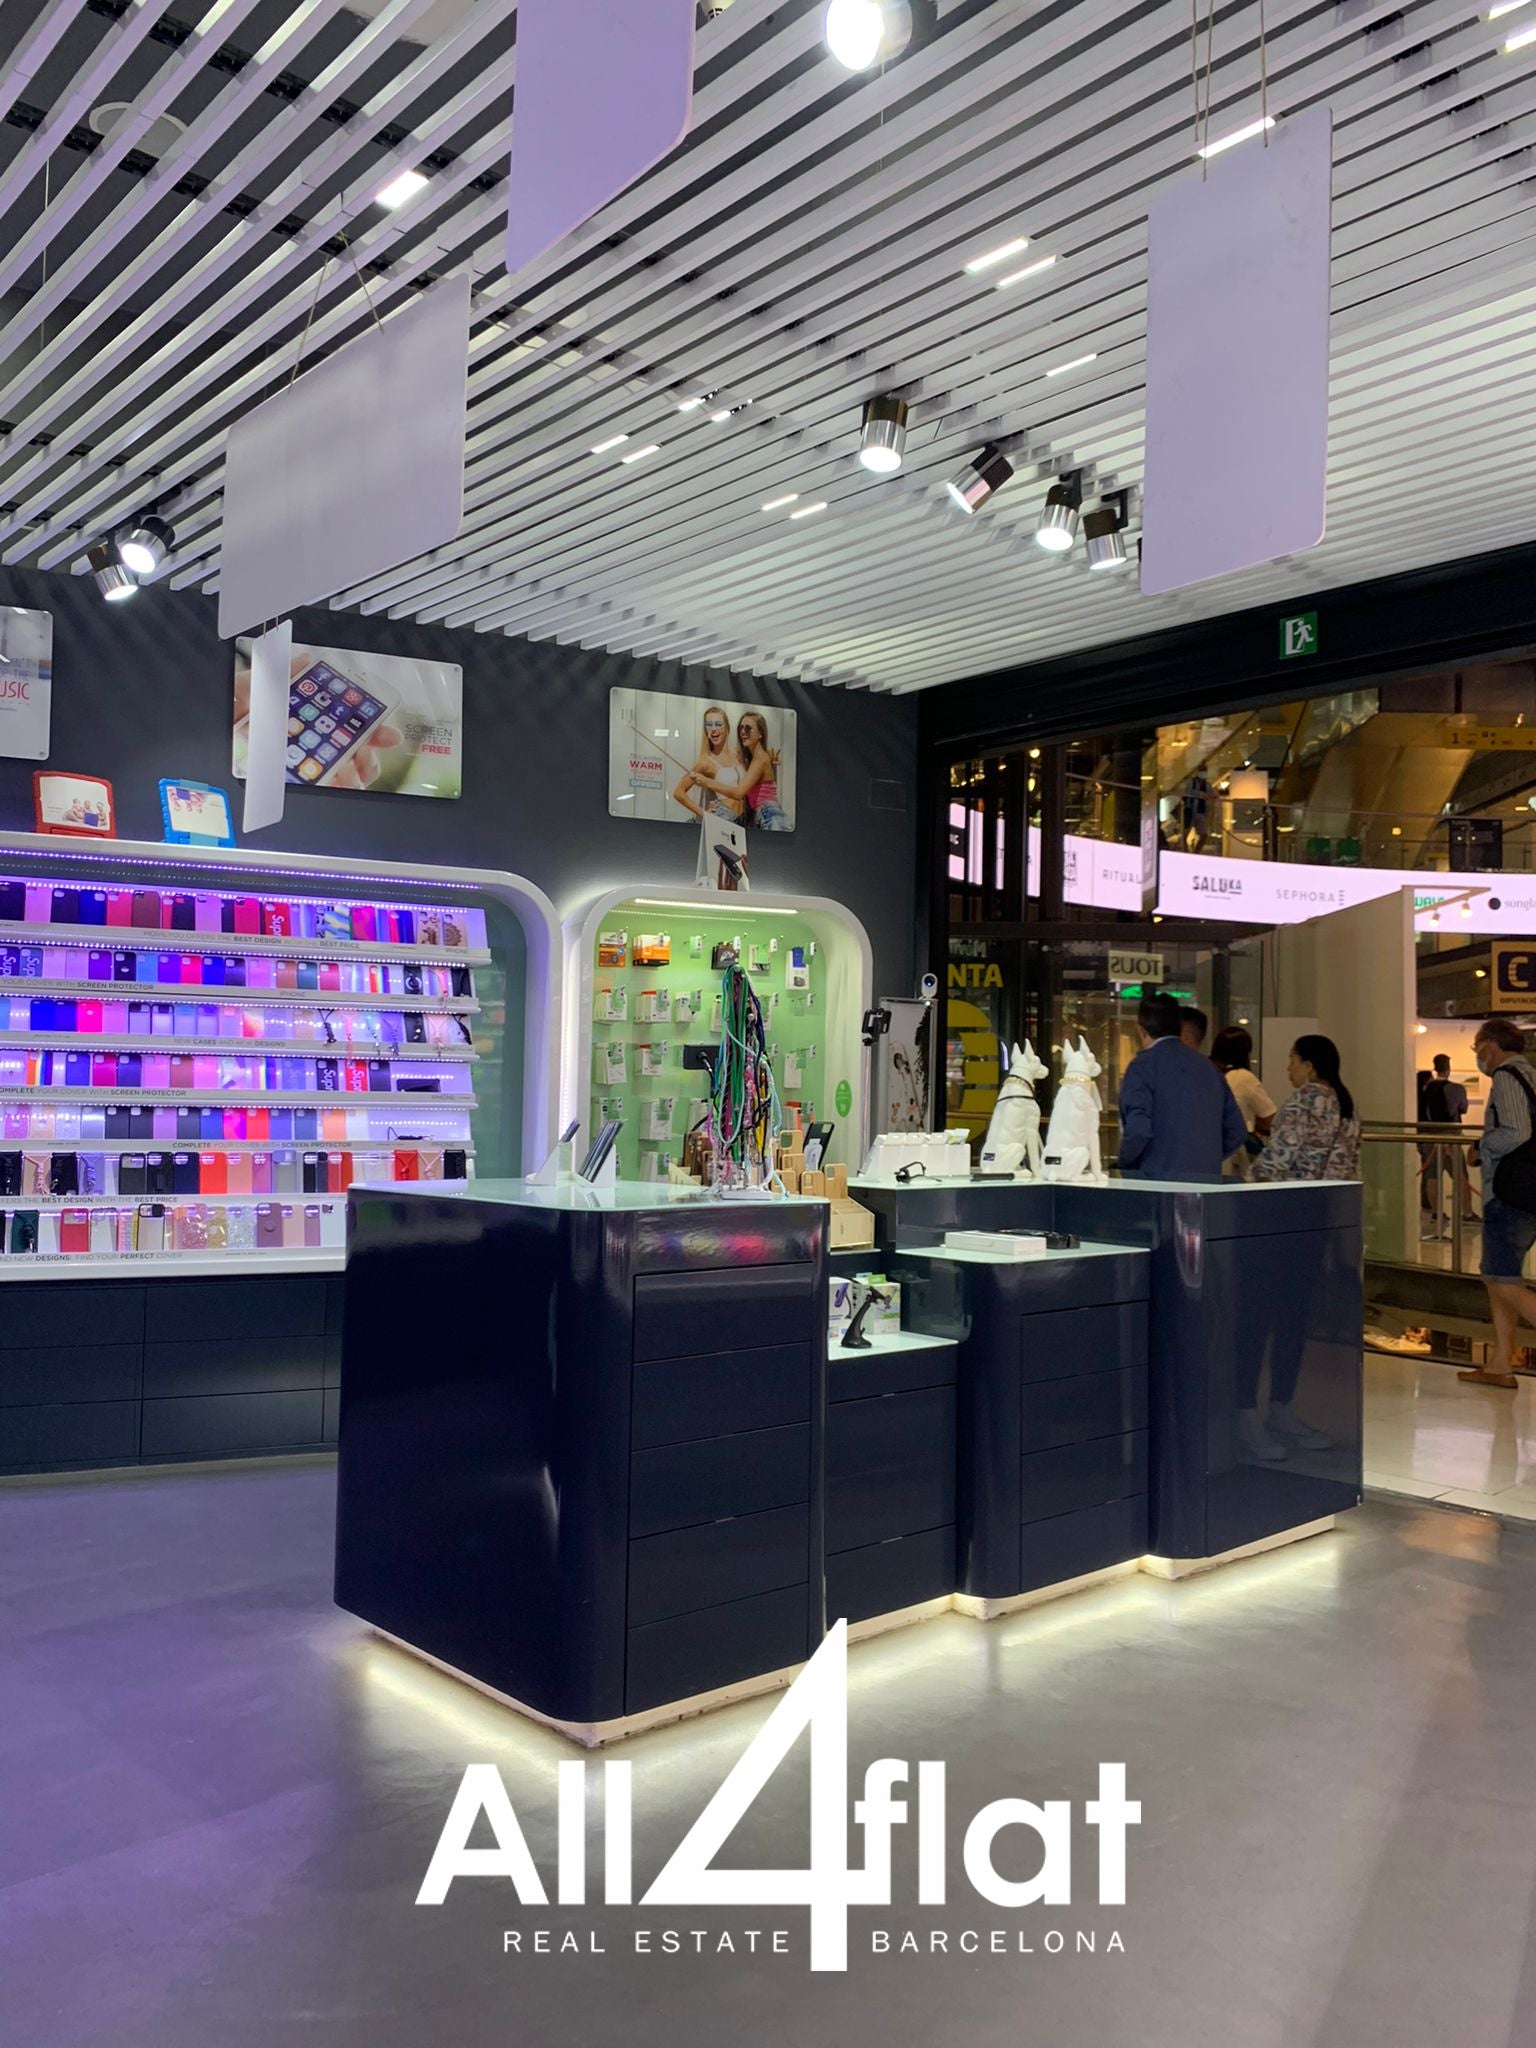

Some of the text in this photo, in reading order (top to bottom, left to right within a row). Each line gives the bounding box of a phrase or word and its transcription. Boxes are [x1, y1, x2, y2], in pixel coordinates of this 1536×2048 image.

[405, 724, 453, 738] SCREEN
[405, 733, 453, 746] PROTECT
[421, 744, 452, 755] FREE
[629, 759, 663, 771] WARM
[1192, 875, 1242, 894] SALUKA
[1275, 889, 1336, 903] SEPHORA
[254, 936, 282, 944] DESIGN
[947, 963, 1004, 988] NTA
[109, 983, 154, 991] PROTECTOR
[281, 1141, 309, 1149] SCREEN
[120, 1252, 155, 1260] PERFECT
